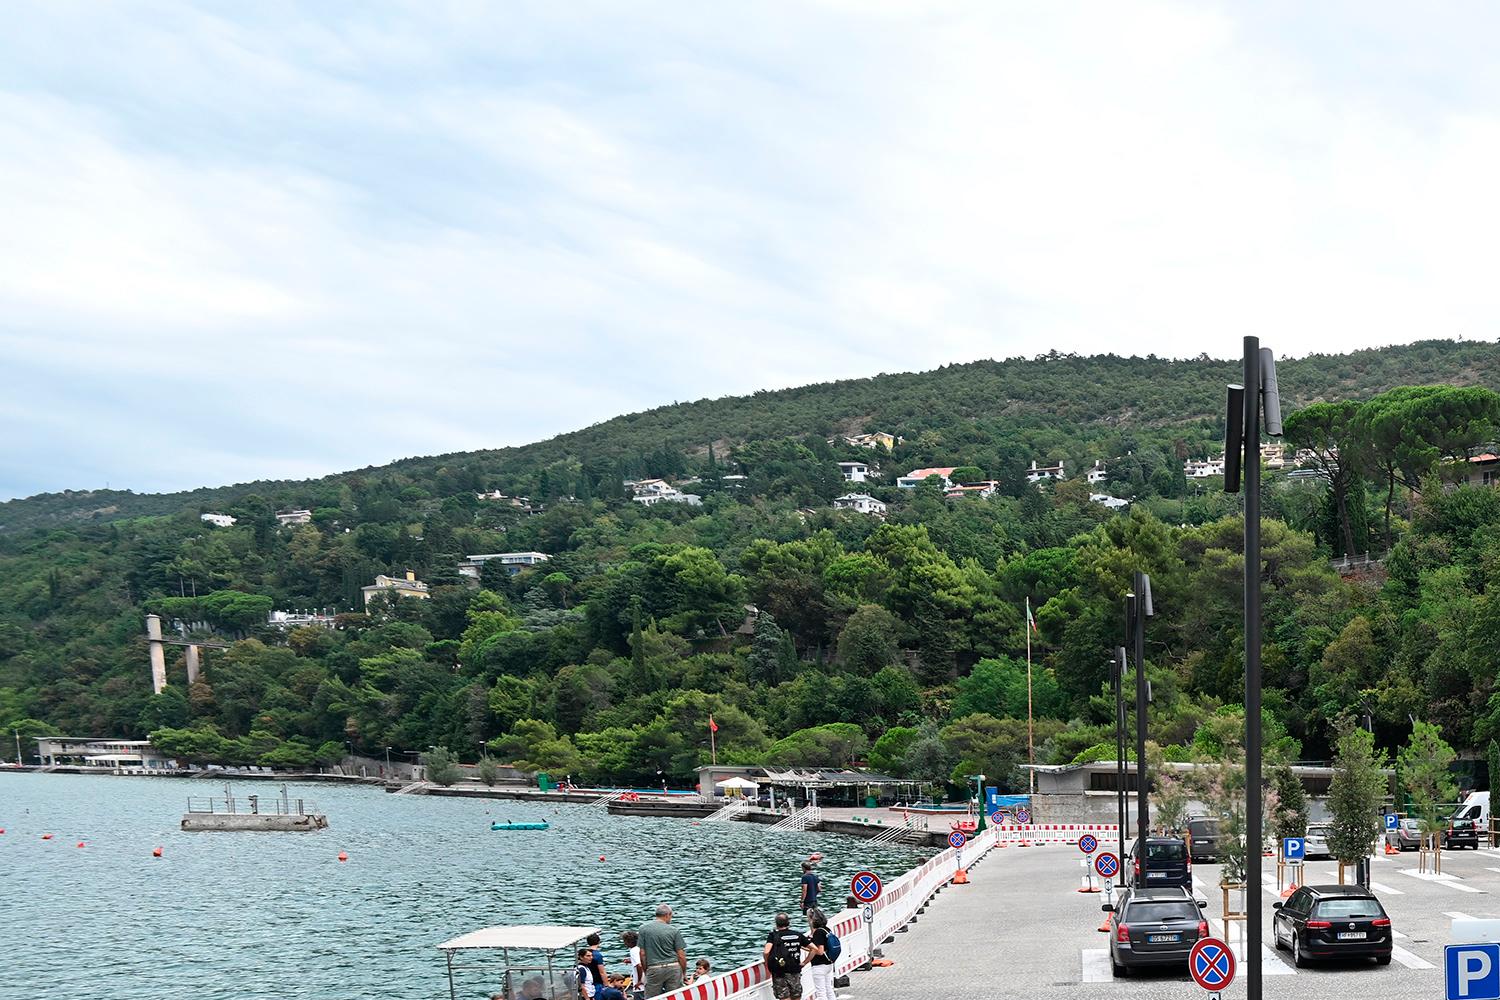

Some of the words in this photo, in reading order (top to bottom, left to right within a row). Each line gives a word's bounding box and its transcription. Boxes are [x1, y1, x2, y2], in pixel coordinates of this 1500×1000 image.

[1387, 816, 1395, 827] P
[1287, 840, 1300, 856] P
[1458, 950, 1492, 996] P
